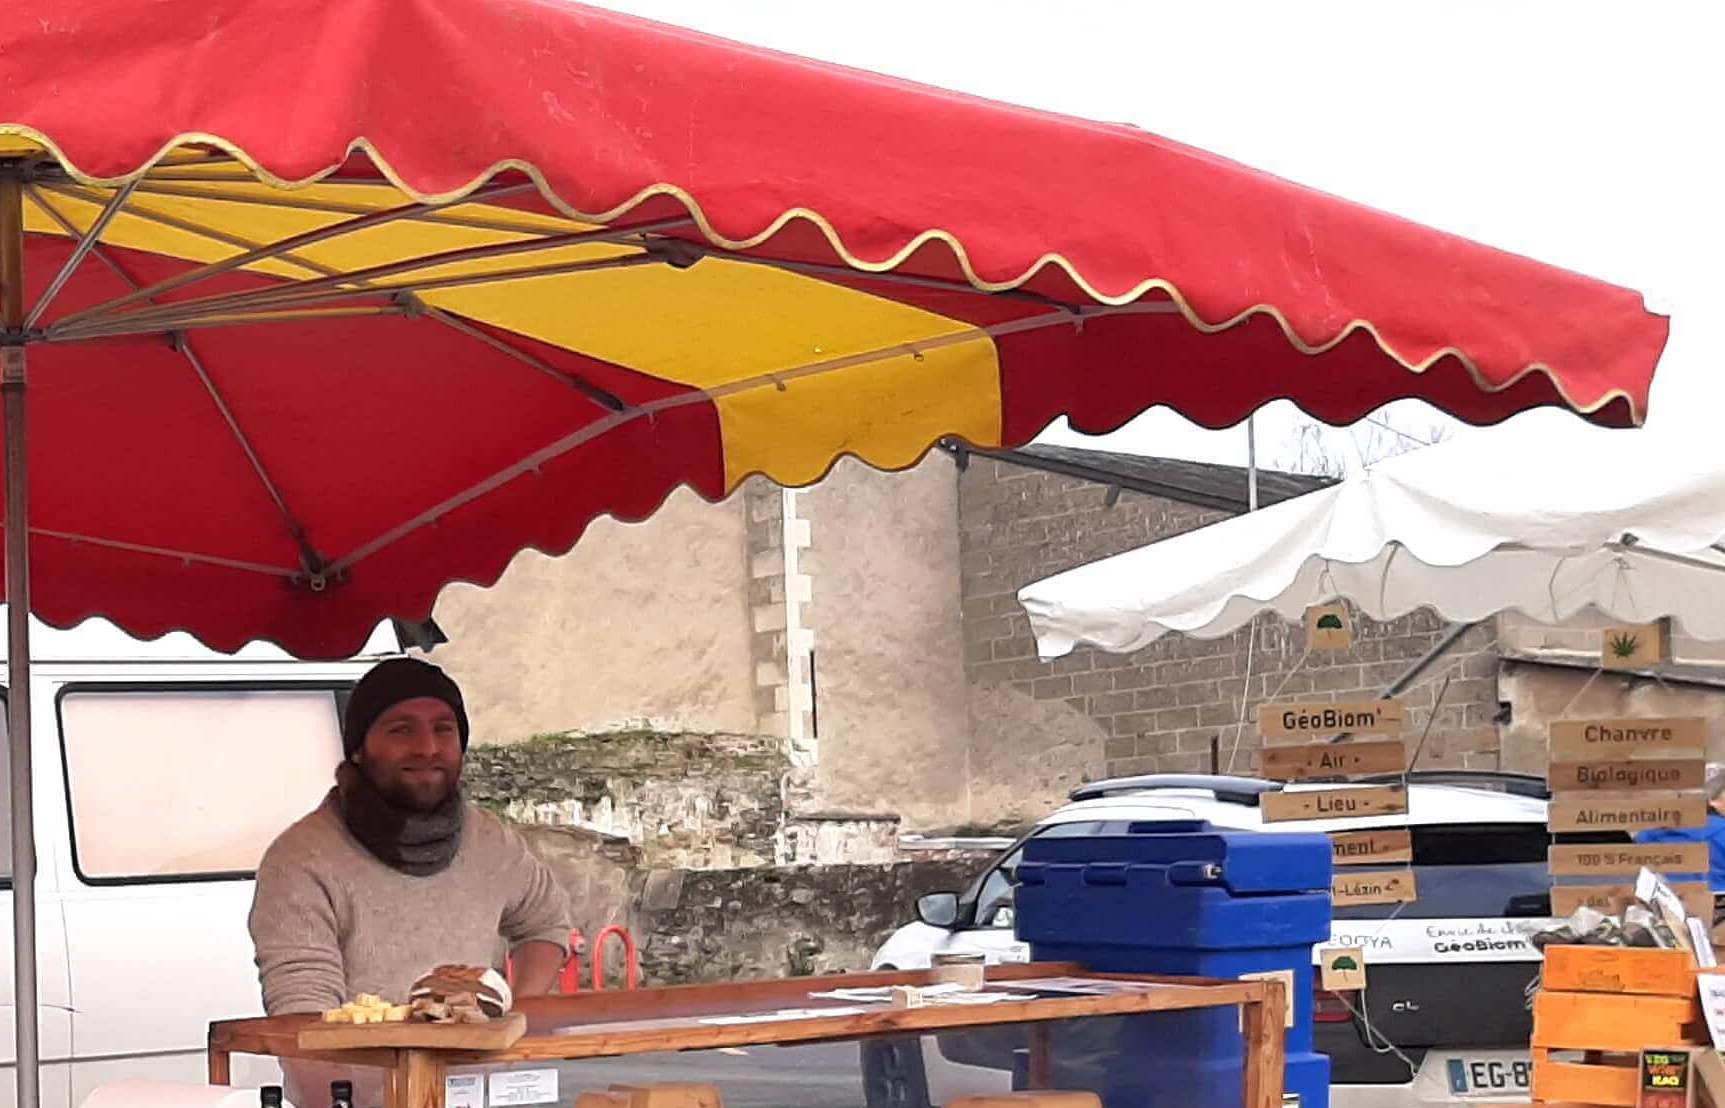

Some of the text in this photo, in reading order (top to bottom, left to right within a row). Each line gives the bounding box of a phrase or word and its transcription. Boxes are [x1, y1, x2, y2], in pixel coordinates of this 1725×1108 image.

[1584, 724, 1673, 743] Chanvre
[1320, 755, 1347, 769] Air
[1577, 766, 1681, 787] Biologique
[1317, 796, 1356, 813] Lieu
[1576, 807, 1683, 827] Alimentaire
[1577, 853, 1601, 867] 100
[1618, 852, 1683, 868] Français
